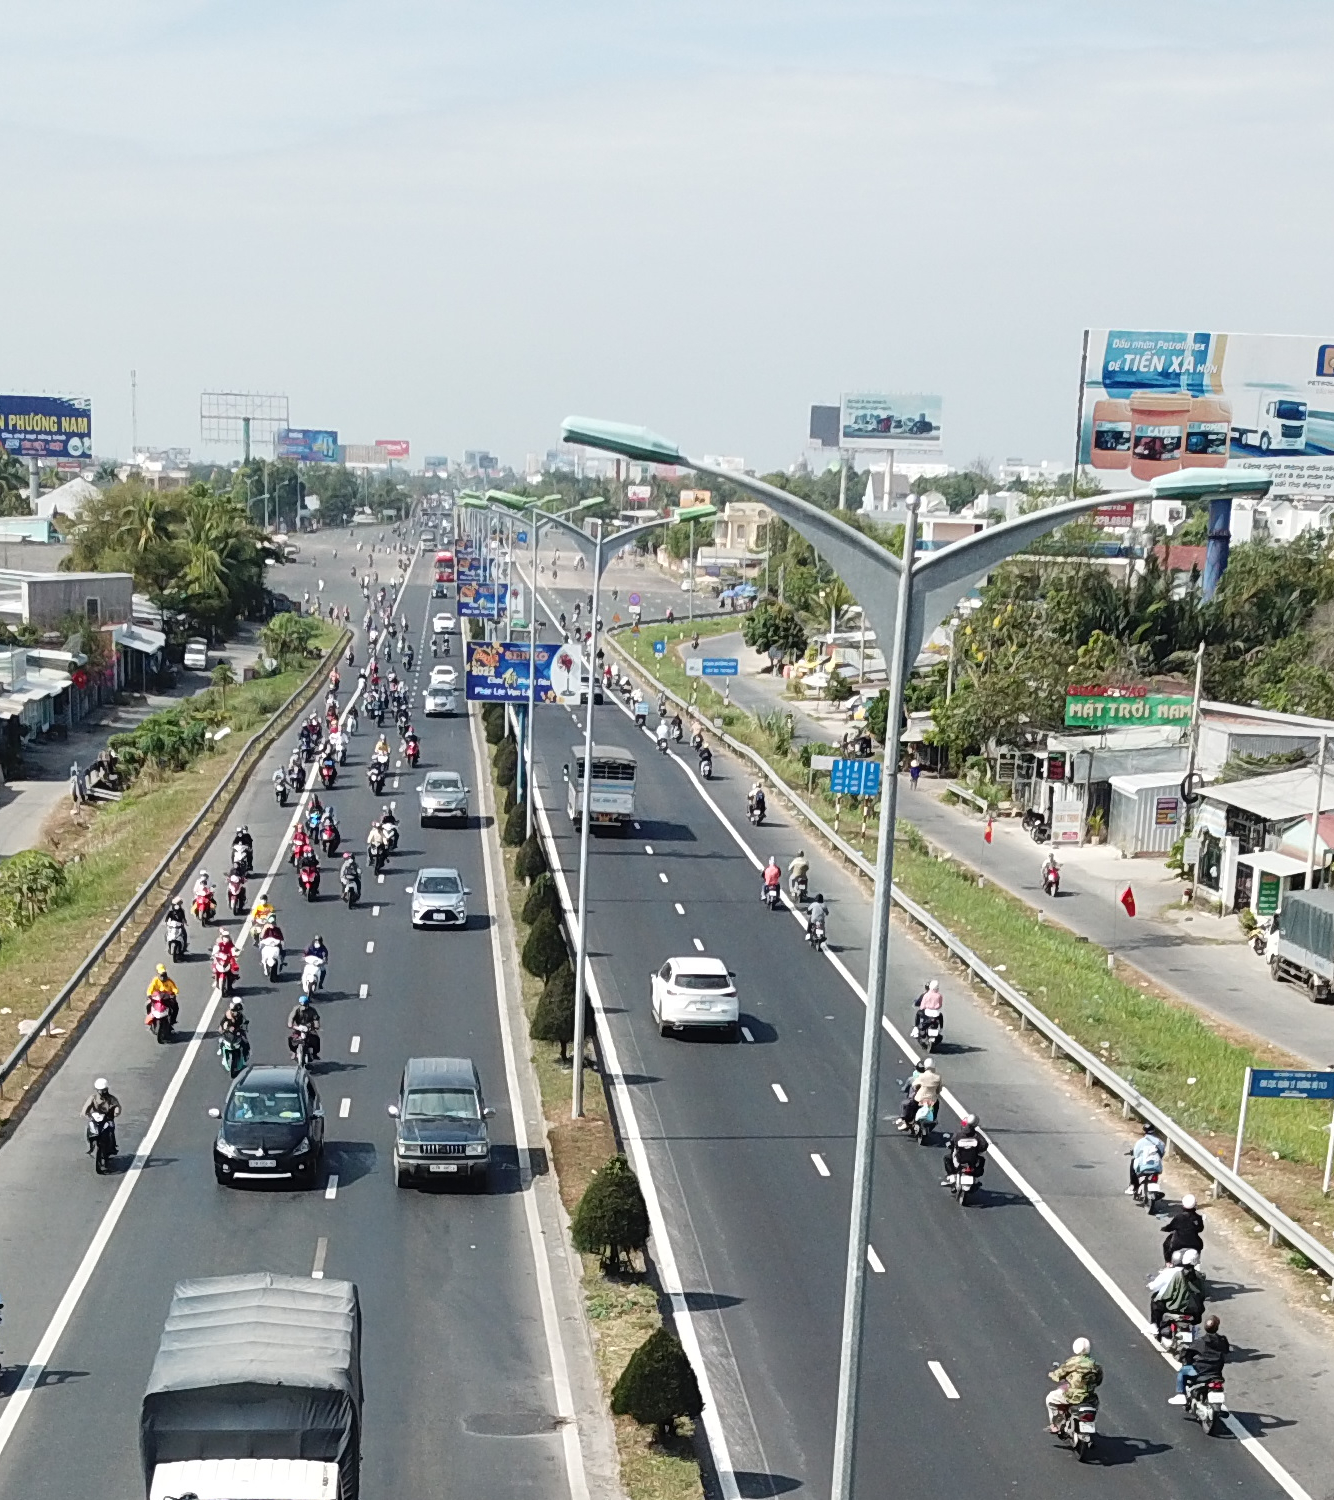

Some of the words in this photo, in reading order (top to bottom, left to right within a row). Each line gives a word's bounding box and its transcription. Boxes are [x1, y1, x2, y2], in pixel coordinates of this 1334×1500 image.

[1156, 340, 1207, 352] Petrolimex
[1123, 349, 1165, 373] TIẾN
[1168, 354, 1195, 373] XA
[8, 412, 58, 431] PHƯƠNG
[61, 416, 88, 433] NAM
[1069, 700, 1104, 721] MẶT
[1107, 699, 1150, 718] TRỜI
[1157, 704, 1193, 719] NAM
